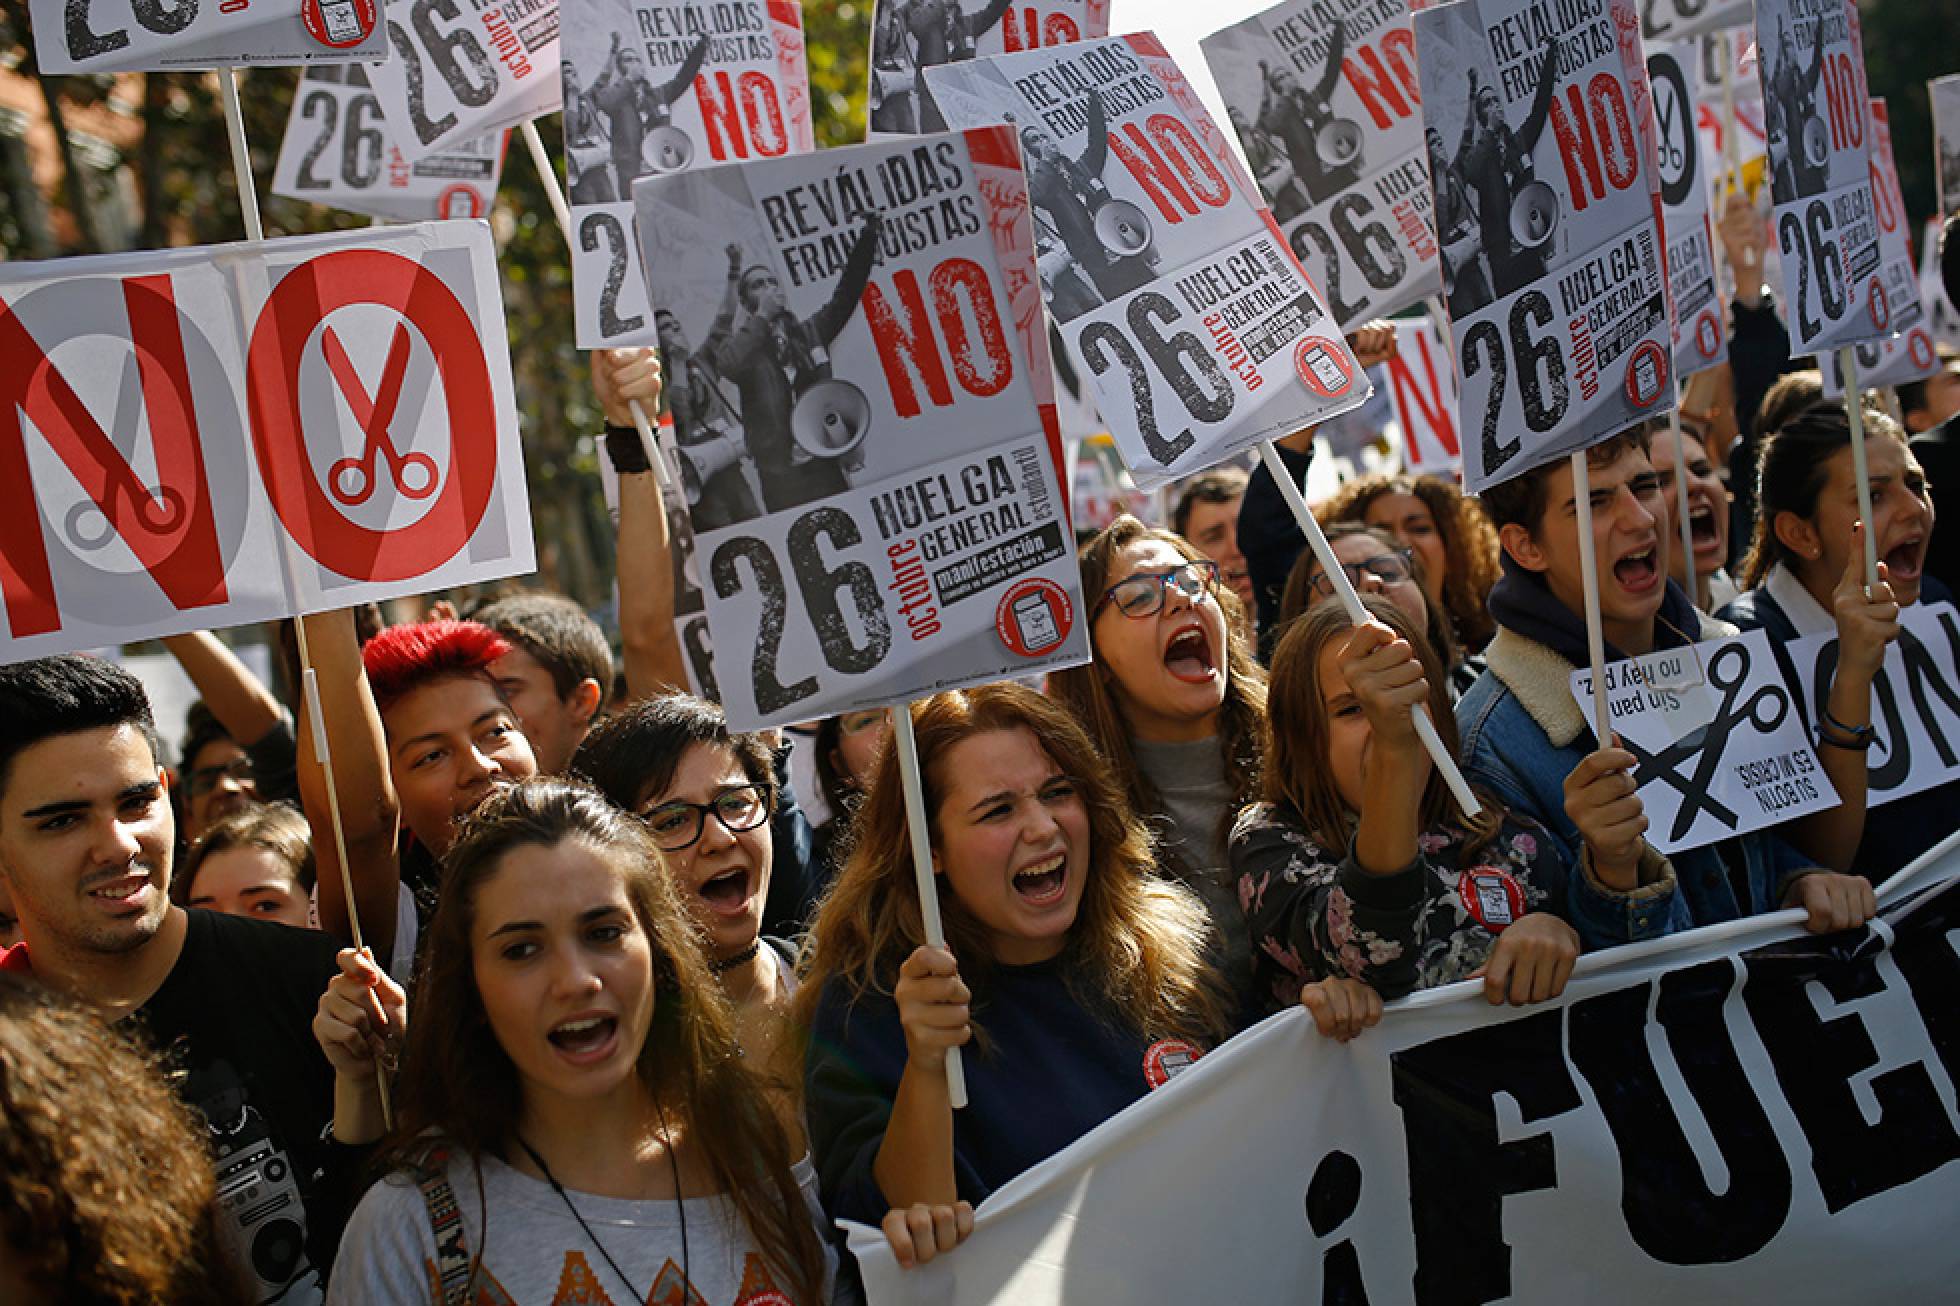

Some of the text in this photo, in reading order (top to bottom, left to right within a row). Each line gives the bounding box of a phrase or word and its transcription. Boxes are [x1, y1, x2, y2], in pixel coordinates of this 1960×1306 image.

[481, 8, 533, 80] octubre
[636, 0, 765, 39] REVÁLIDAS
[645, 35, 774, 67] FRANUISTAS
[1289, 0, 1405, 73] FRANUISTAS
[1501, 19, 1615, 103] FRANUISTAS
[387, 0, 499, 146] 26
[693, 69, 789, 162] NO
[1014, 42, 1140, 110] REVÁLIDAS
[1042, 73, 1166, 140] FRANUISTAS
[1340, 27, 1422, 131] NO
[1819, 53, 1863, 152] NO
[296, 90, 385, 190] 26
[1107, 113, 1231, 224] NO
[1374, 158, 1429, 205] HUEL
[1548, 71, 1639, 212] NO
[761, 140, 964, 243] REVÁLIDAS
[782, 195, 982, 288] FRANUISTAS
[1174, 247, 1270, 314] HUELGA
[1291, 193, 1407, 328] 26
[1559, 237, 1640, 317] HUELGA
[1780, 200, 1847, 345] 26
[861, 257, 1013, 419] NO
[1220, 281, 1290, 331] GENERAL
[1587, 278, 1649, 333] GENERAL
[1079, 291, 1235, 466] 26
[1203, 311, 1264, 392] octubre
[1462, 290, 1569, 478] 26
[1569, 314, 1599, 401] octubre
[0, 248, 497, 640] NO
[870, 455, 1017, 540] HUELGA
[919, 502, 1032, 562] GENERAL
[711, 506, 892, 717] 26
[887, 539, 942, 641] octubre
[1577, 667, 1616, 697] pz.
[1610, 690, 1645, 719] pan
[1660, 657, 1681, 679] no
[1306, 872, 1960, 1306] ¡FUE
